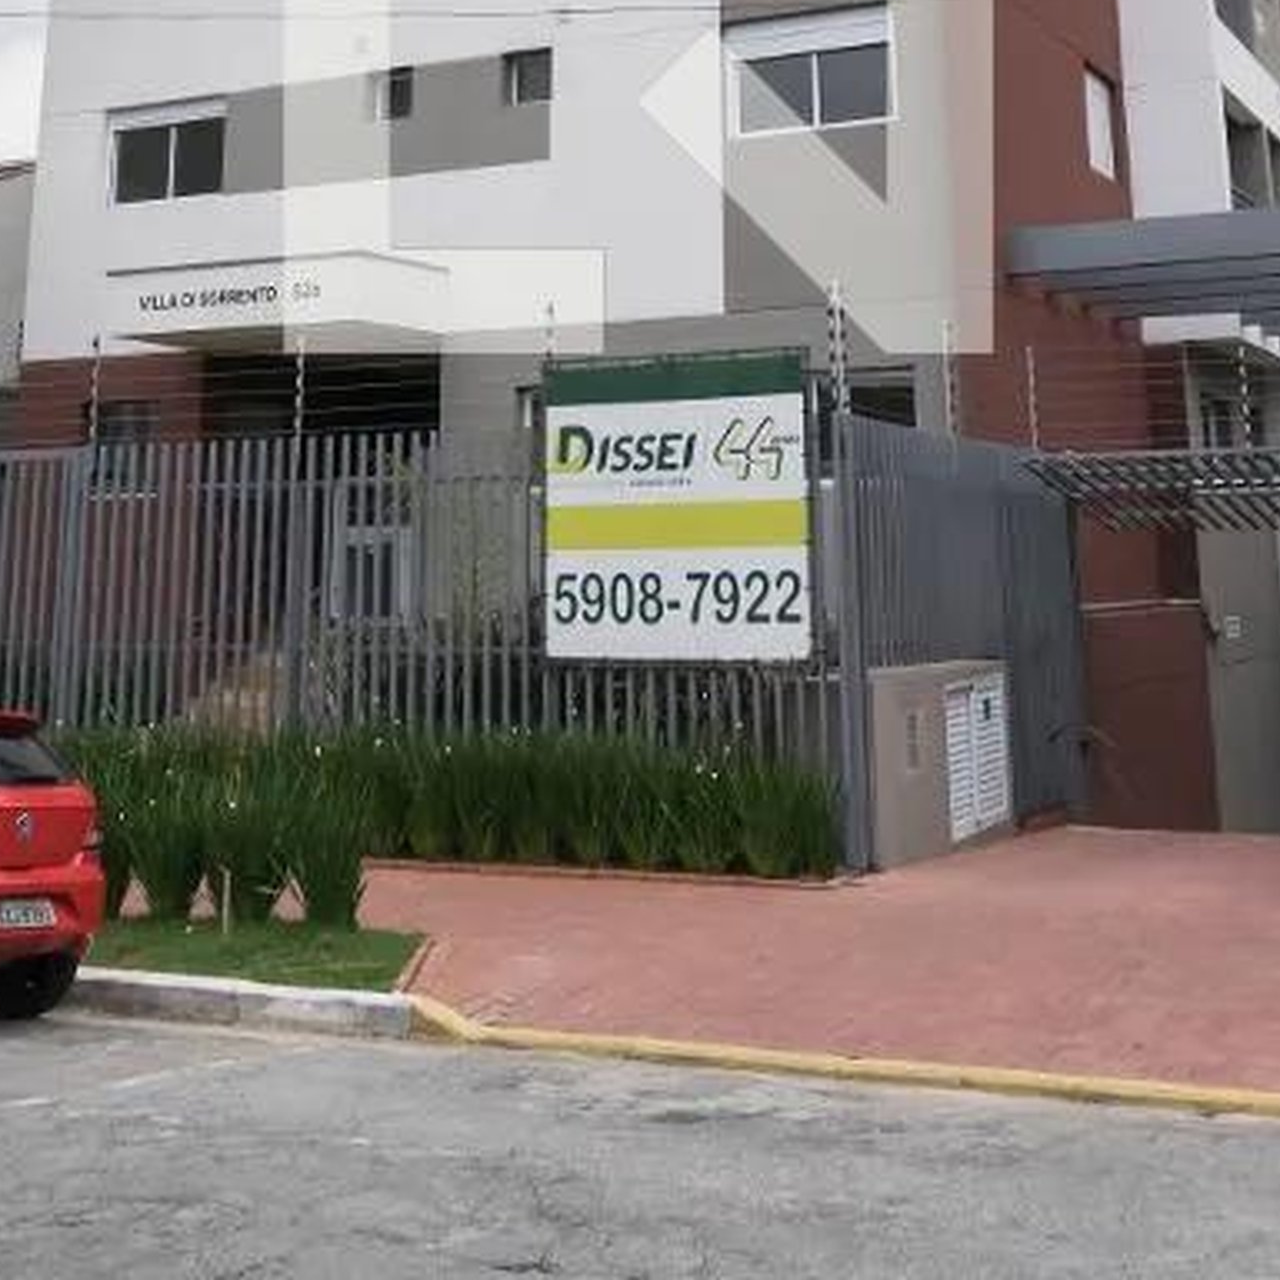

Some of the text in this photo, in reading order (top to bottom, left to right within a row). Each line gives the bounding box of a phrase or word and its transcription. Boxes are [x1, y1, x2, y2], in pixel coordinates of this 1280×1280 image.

[139, 293, 177, 311] VILLA
[199, 285, 278, 308] SORRENTO
[550, 424, 697, 473] DISSEI
[554, 570, 802, 625] 5908-7922
